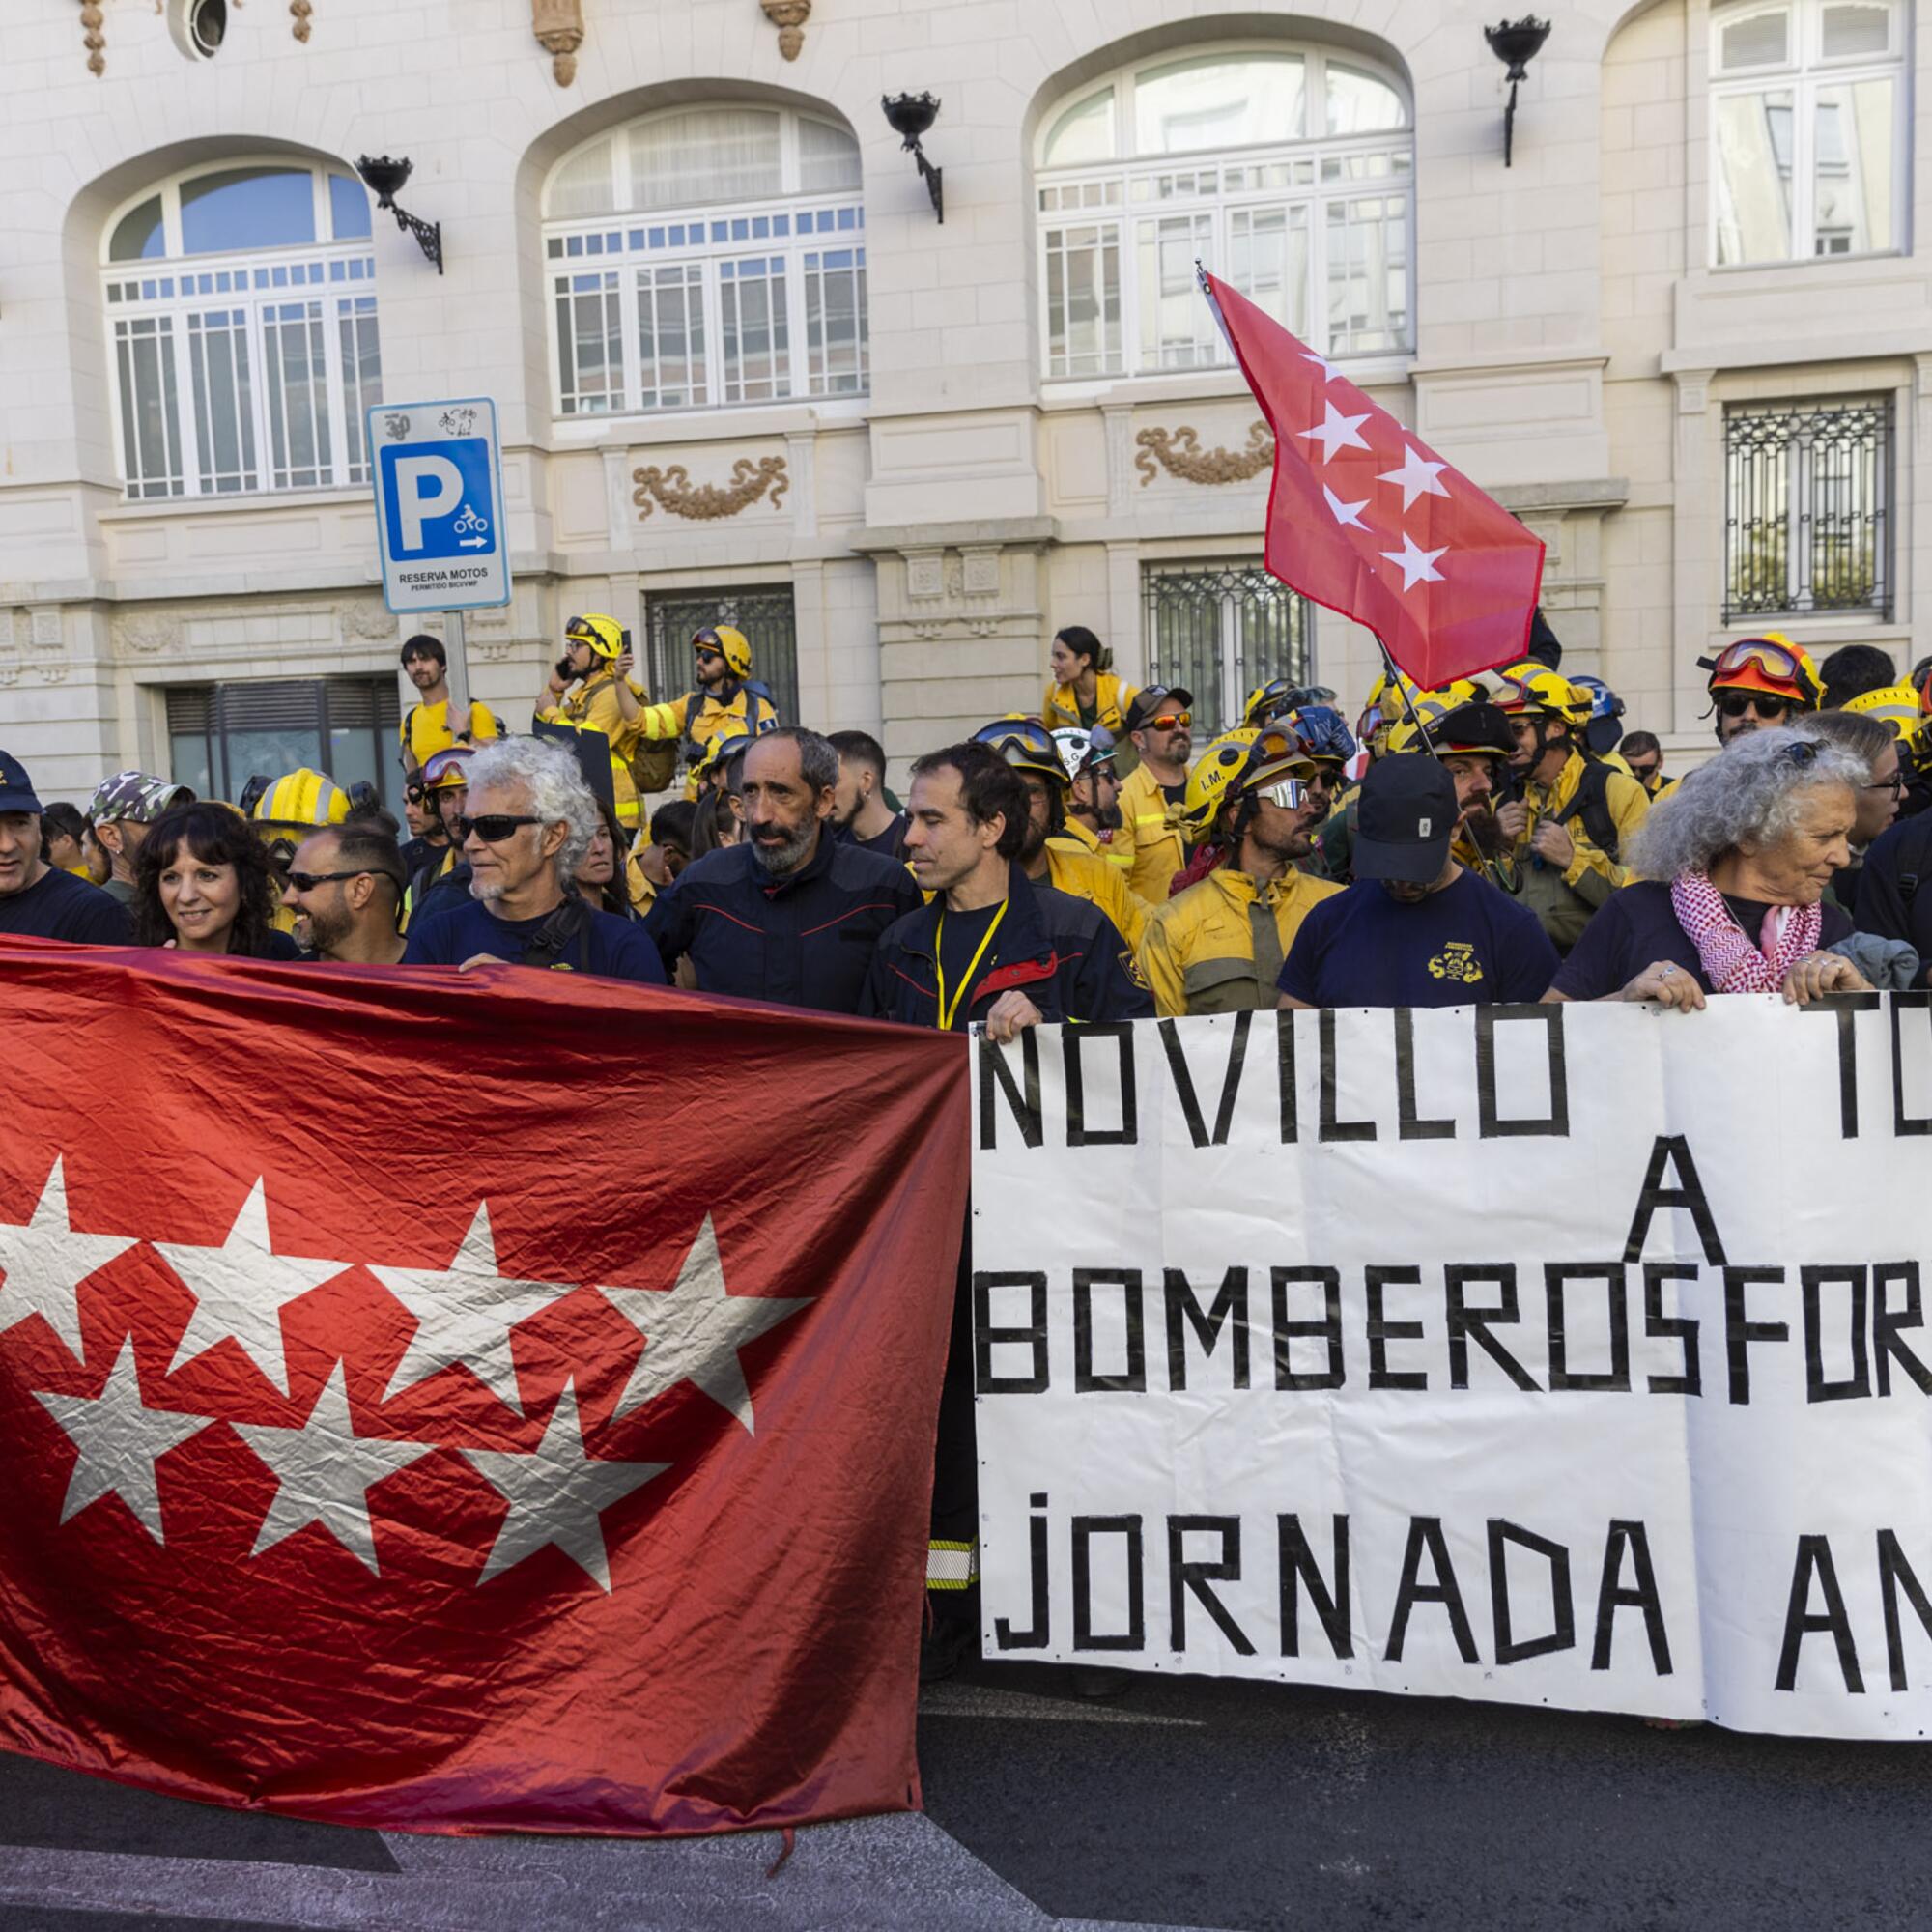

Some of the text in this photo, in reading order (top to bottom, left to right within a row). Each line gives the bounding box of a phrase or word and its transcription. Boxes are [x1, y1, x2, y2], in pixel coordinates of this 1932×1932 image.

[394, 455, 464, 551] P
[399, 567, 488, 583] RESERVA MOTOS
[980, 1003, 1569, 1150] NOVILLO
[1622, 1134, 1729, 1266] A
